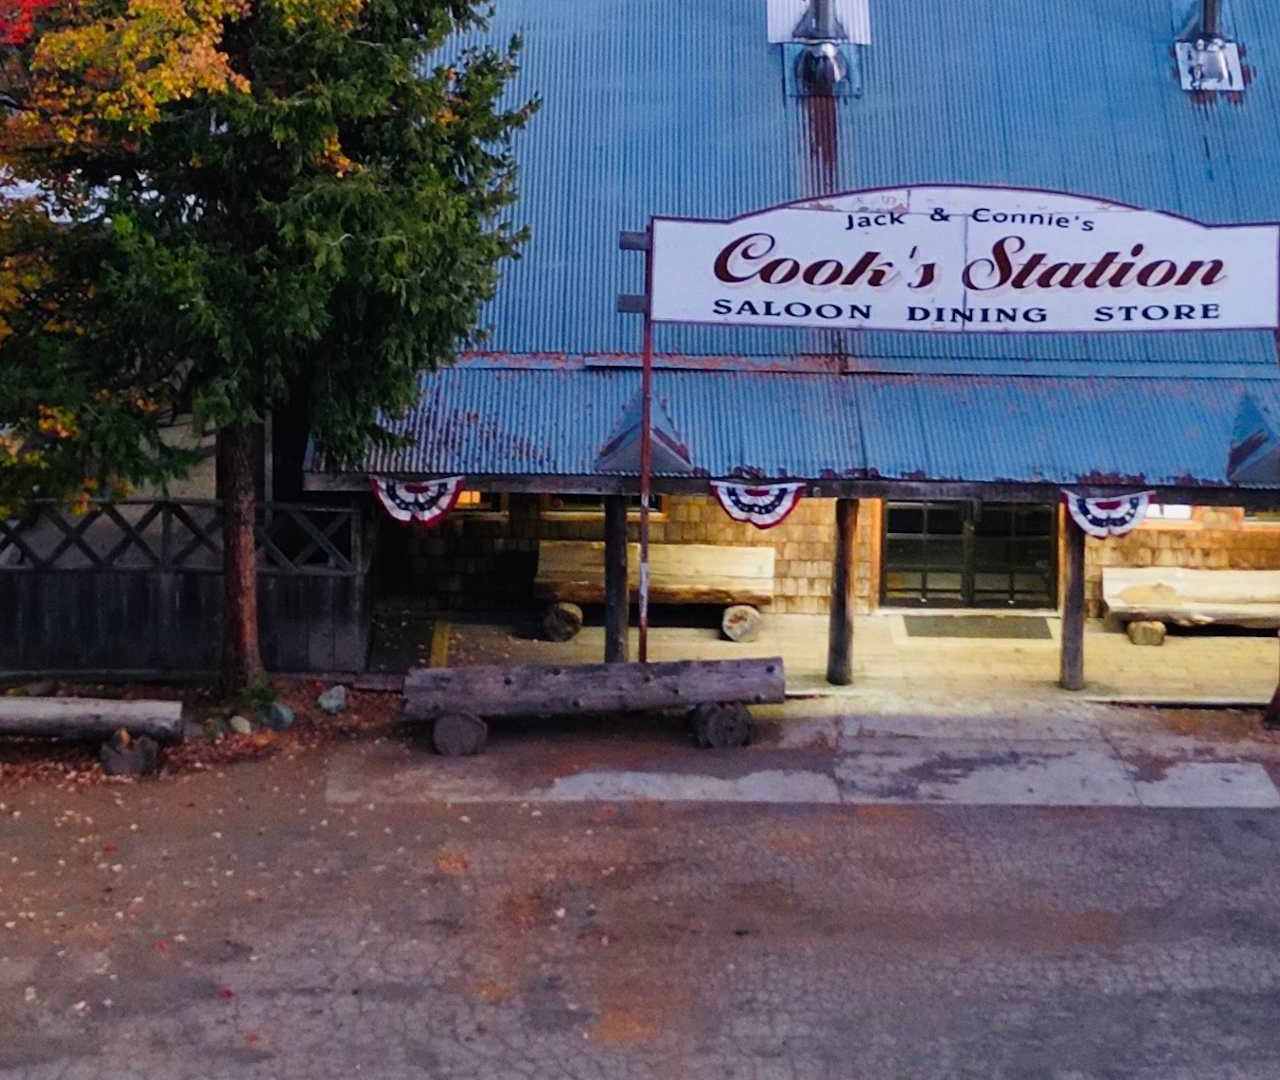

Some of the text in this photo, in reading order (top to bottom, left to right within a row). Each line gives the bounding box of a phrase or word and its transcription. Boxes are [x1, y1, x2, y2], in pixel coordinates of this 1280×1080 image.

[845, 208, 1095, 231] Jack & Connie's
[713, 232, 1227, 291] Cook's Station
[713, 299, 1220, 323] SALOON DINING STORE
